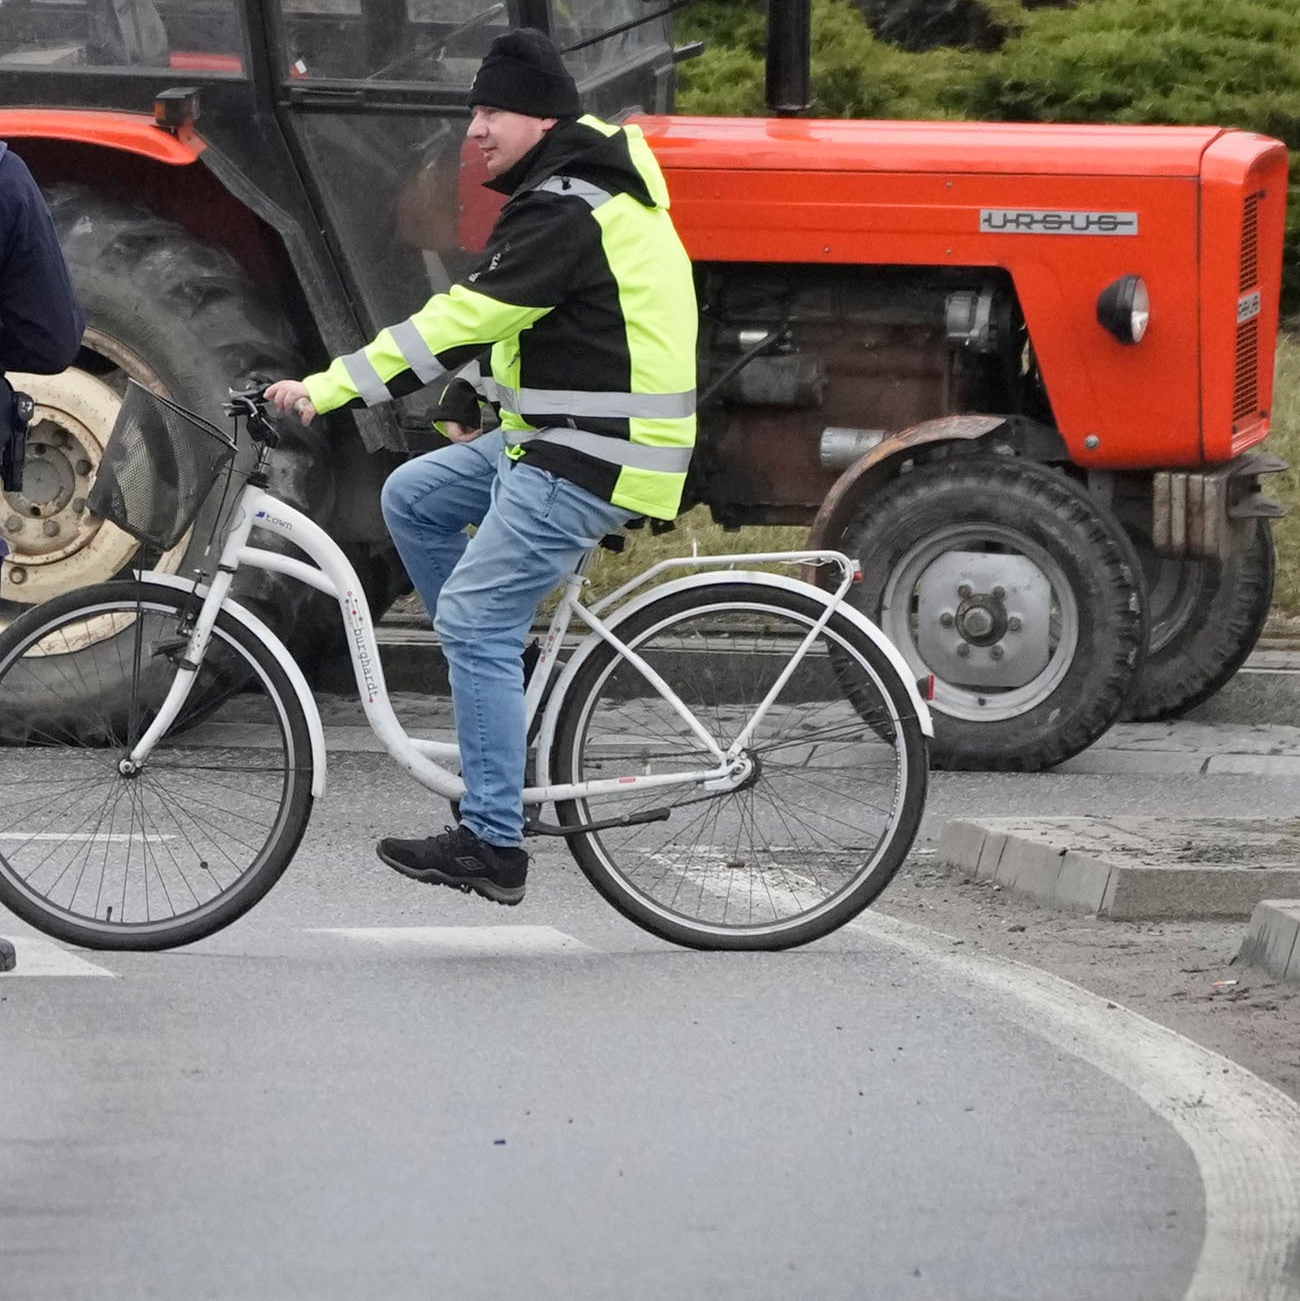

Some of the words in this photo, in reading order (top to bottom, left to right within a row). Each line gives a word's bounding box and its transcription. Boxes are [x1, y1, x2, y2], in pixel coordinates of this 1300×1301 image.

[984, 212, 1132, 231] URSUS
[266, 514, 293, 530] town
[353, 627, 379, 698] burghardt
